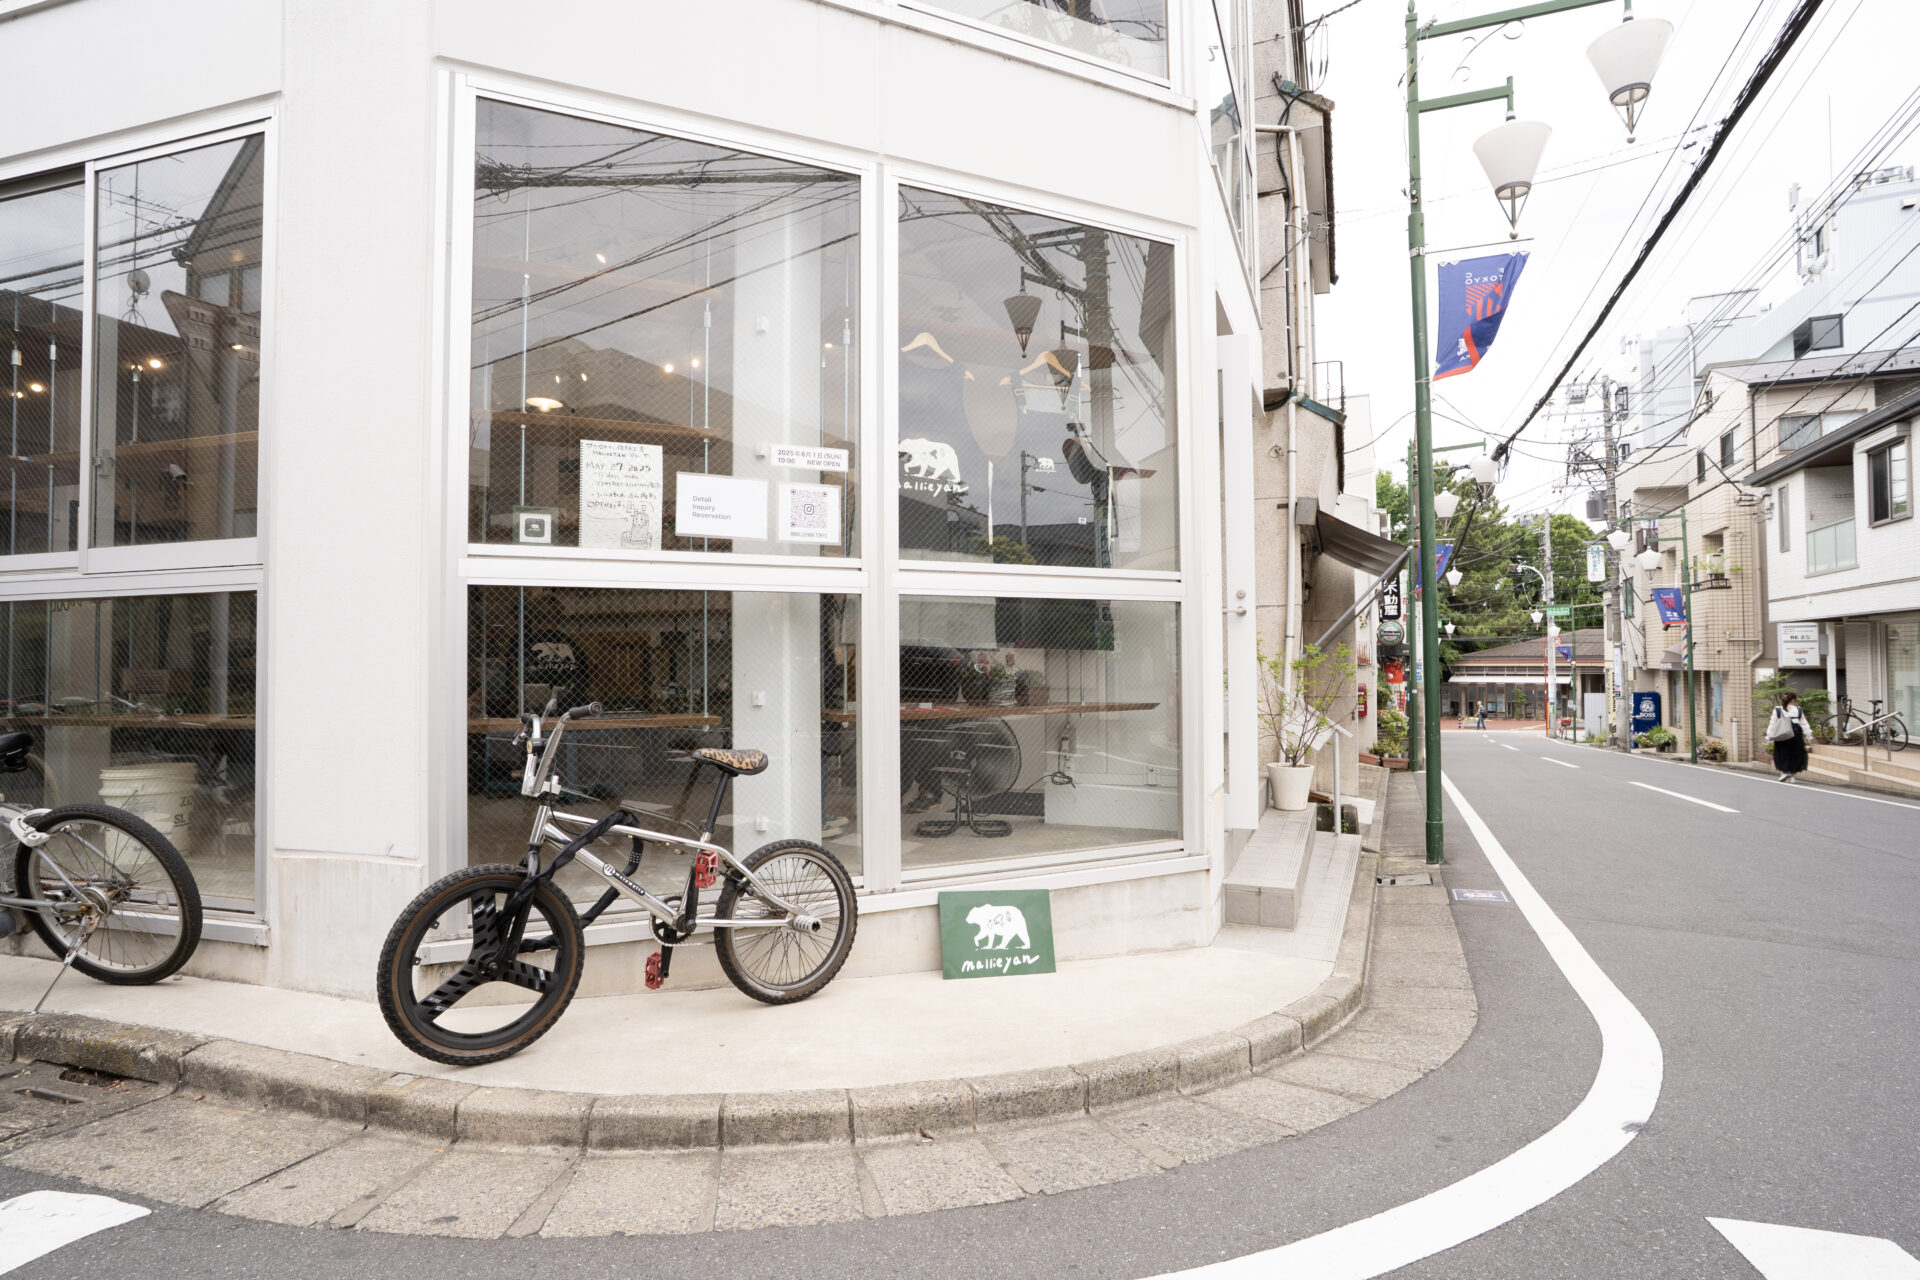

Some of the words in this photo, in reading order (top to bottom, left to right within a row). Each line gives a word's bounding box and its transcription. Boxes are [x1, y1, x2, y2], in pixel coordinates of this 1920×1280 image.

[777, 457, 796, 465] 10:00
[692, 495, 712, 503] Detail
[692, 504, 716, 512] Inquiry
[692, 511, 732, 520] Reservation
[961, 954, 1040, 974] mallieyan
